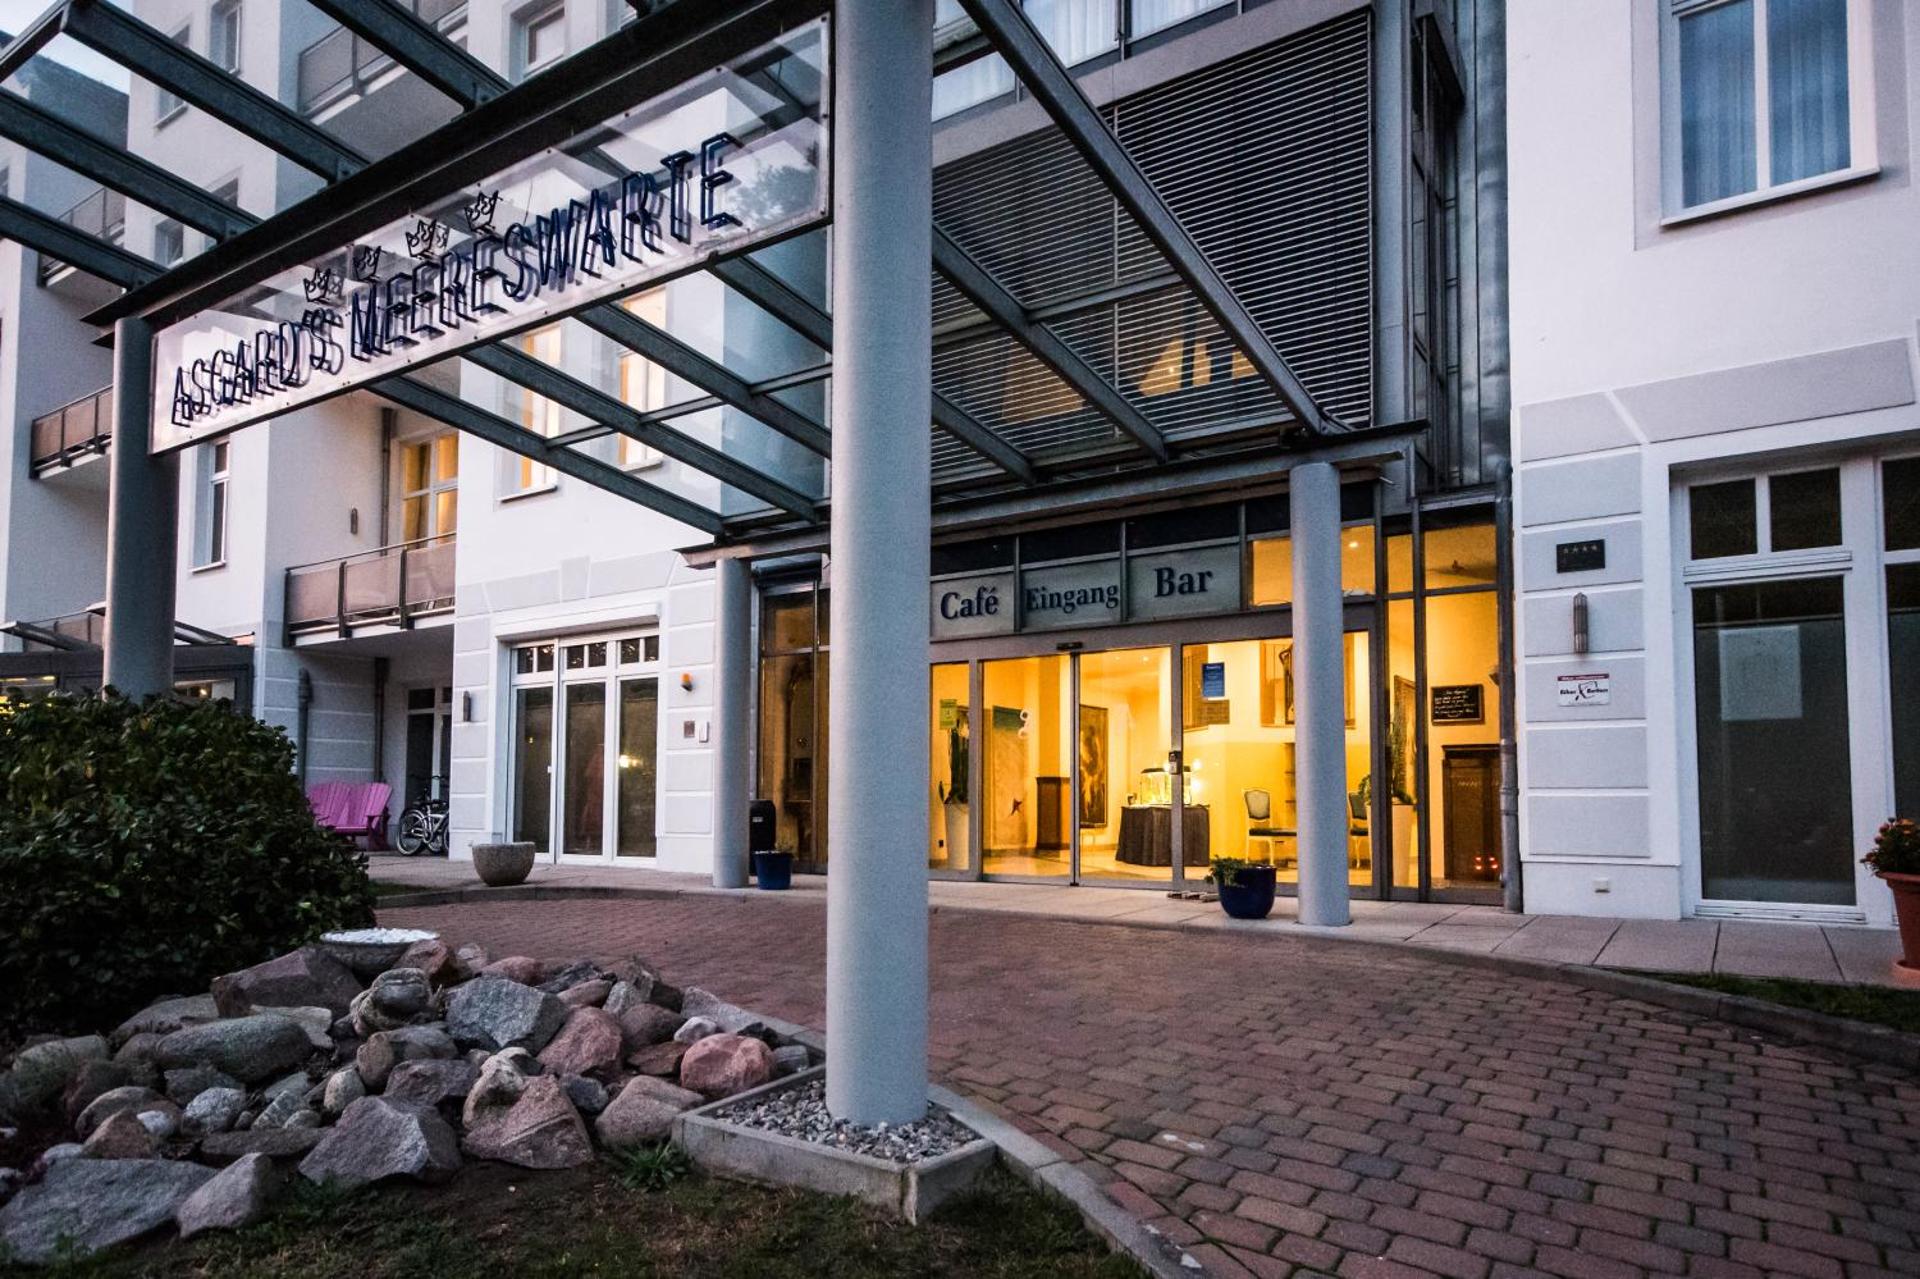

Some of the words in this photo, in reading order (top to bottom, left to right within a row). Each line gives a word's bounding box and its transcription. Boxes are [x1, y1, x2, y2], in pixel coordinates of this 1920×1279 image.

[350, 131, 744, 362] MEERESWARTE
[1154, 566, 1213, 598] Bar
[940, 586, 999, 620] Café
[1025, 584, 1119, 614] Eingang
